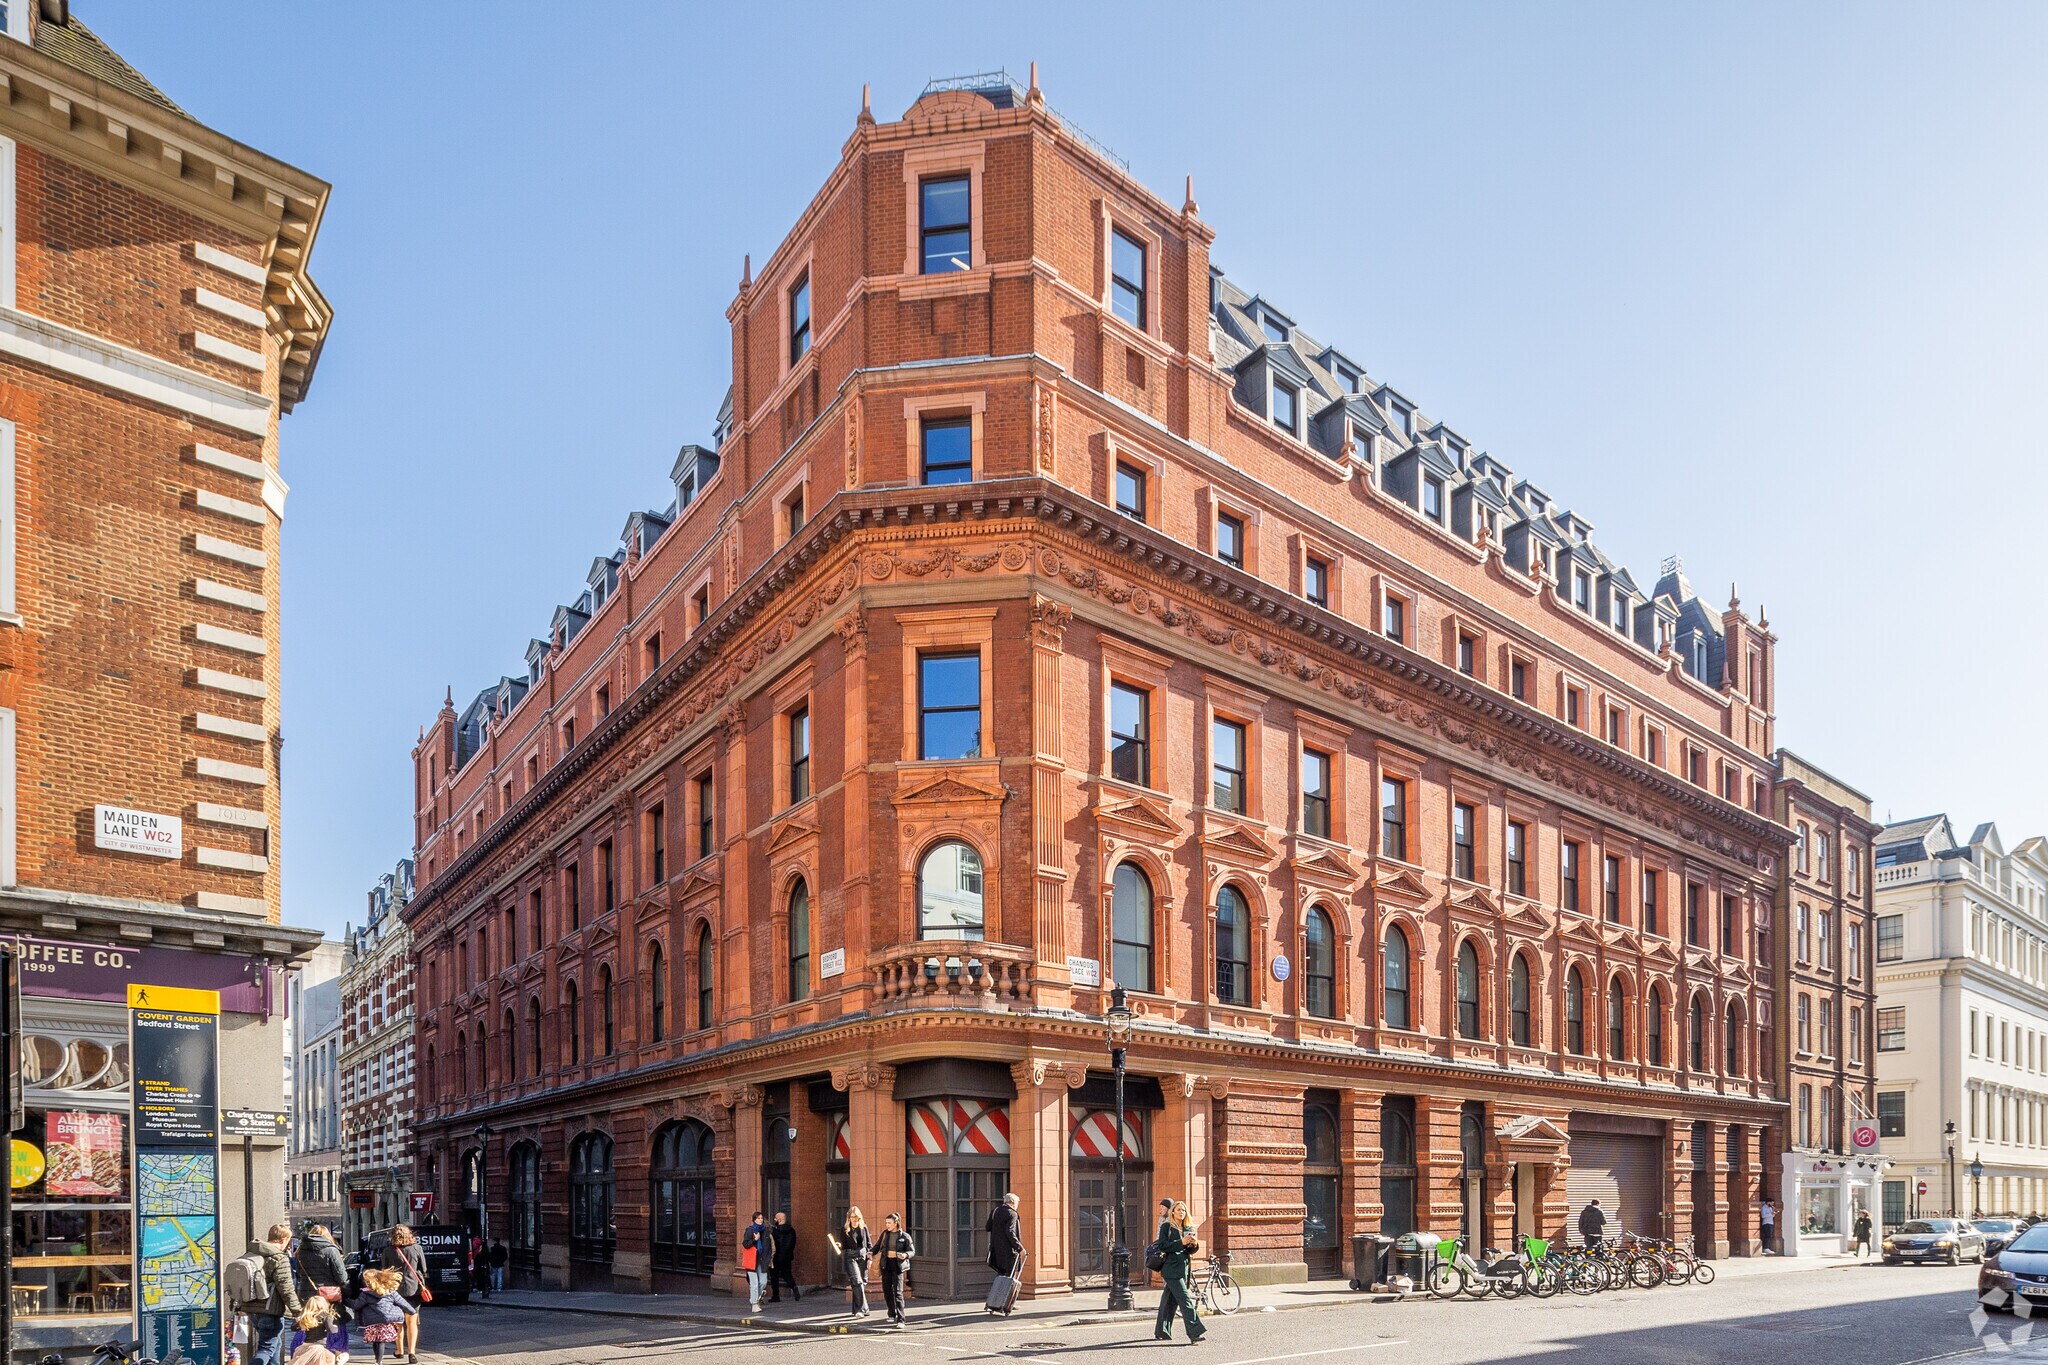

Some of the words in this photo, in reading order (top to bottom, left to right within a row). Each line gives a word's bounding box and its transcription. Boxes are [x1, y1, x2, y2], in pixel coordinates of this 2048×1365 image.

[104, 810, 158, 829] MAIDEN
[104, 823, 138, 838] LANE
[144, 829, 173, 844] WC2
[104, 839, 118, 847] CITY
[129, 843, 172, 855] WESTMINSTER
[94, 951, 132, 969] CO.
[23, 962, 56, 973] 1999
[137, 1012, 174, 1021] COVENT
[175, 1015, 212, 1024] GARDEN
[137, 1019, 172, 1028] Bedford
[173, 1022, 200, 1031] Street
[57, 1115, 112, 1126] ALL-DAY
[226, 1111, 254, 1120] Charing
[255, 1112, 275, 1120] Cross
[250, 1119, 275, 1127] Station
[57, 1125, 111, 1135] BRUNCH
[11, 1150, 28, 1162] EW
[414, 1197, 427, 1209] F
[415, 1235, 461, 1245] BSIDIAN
